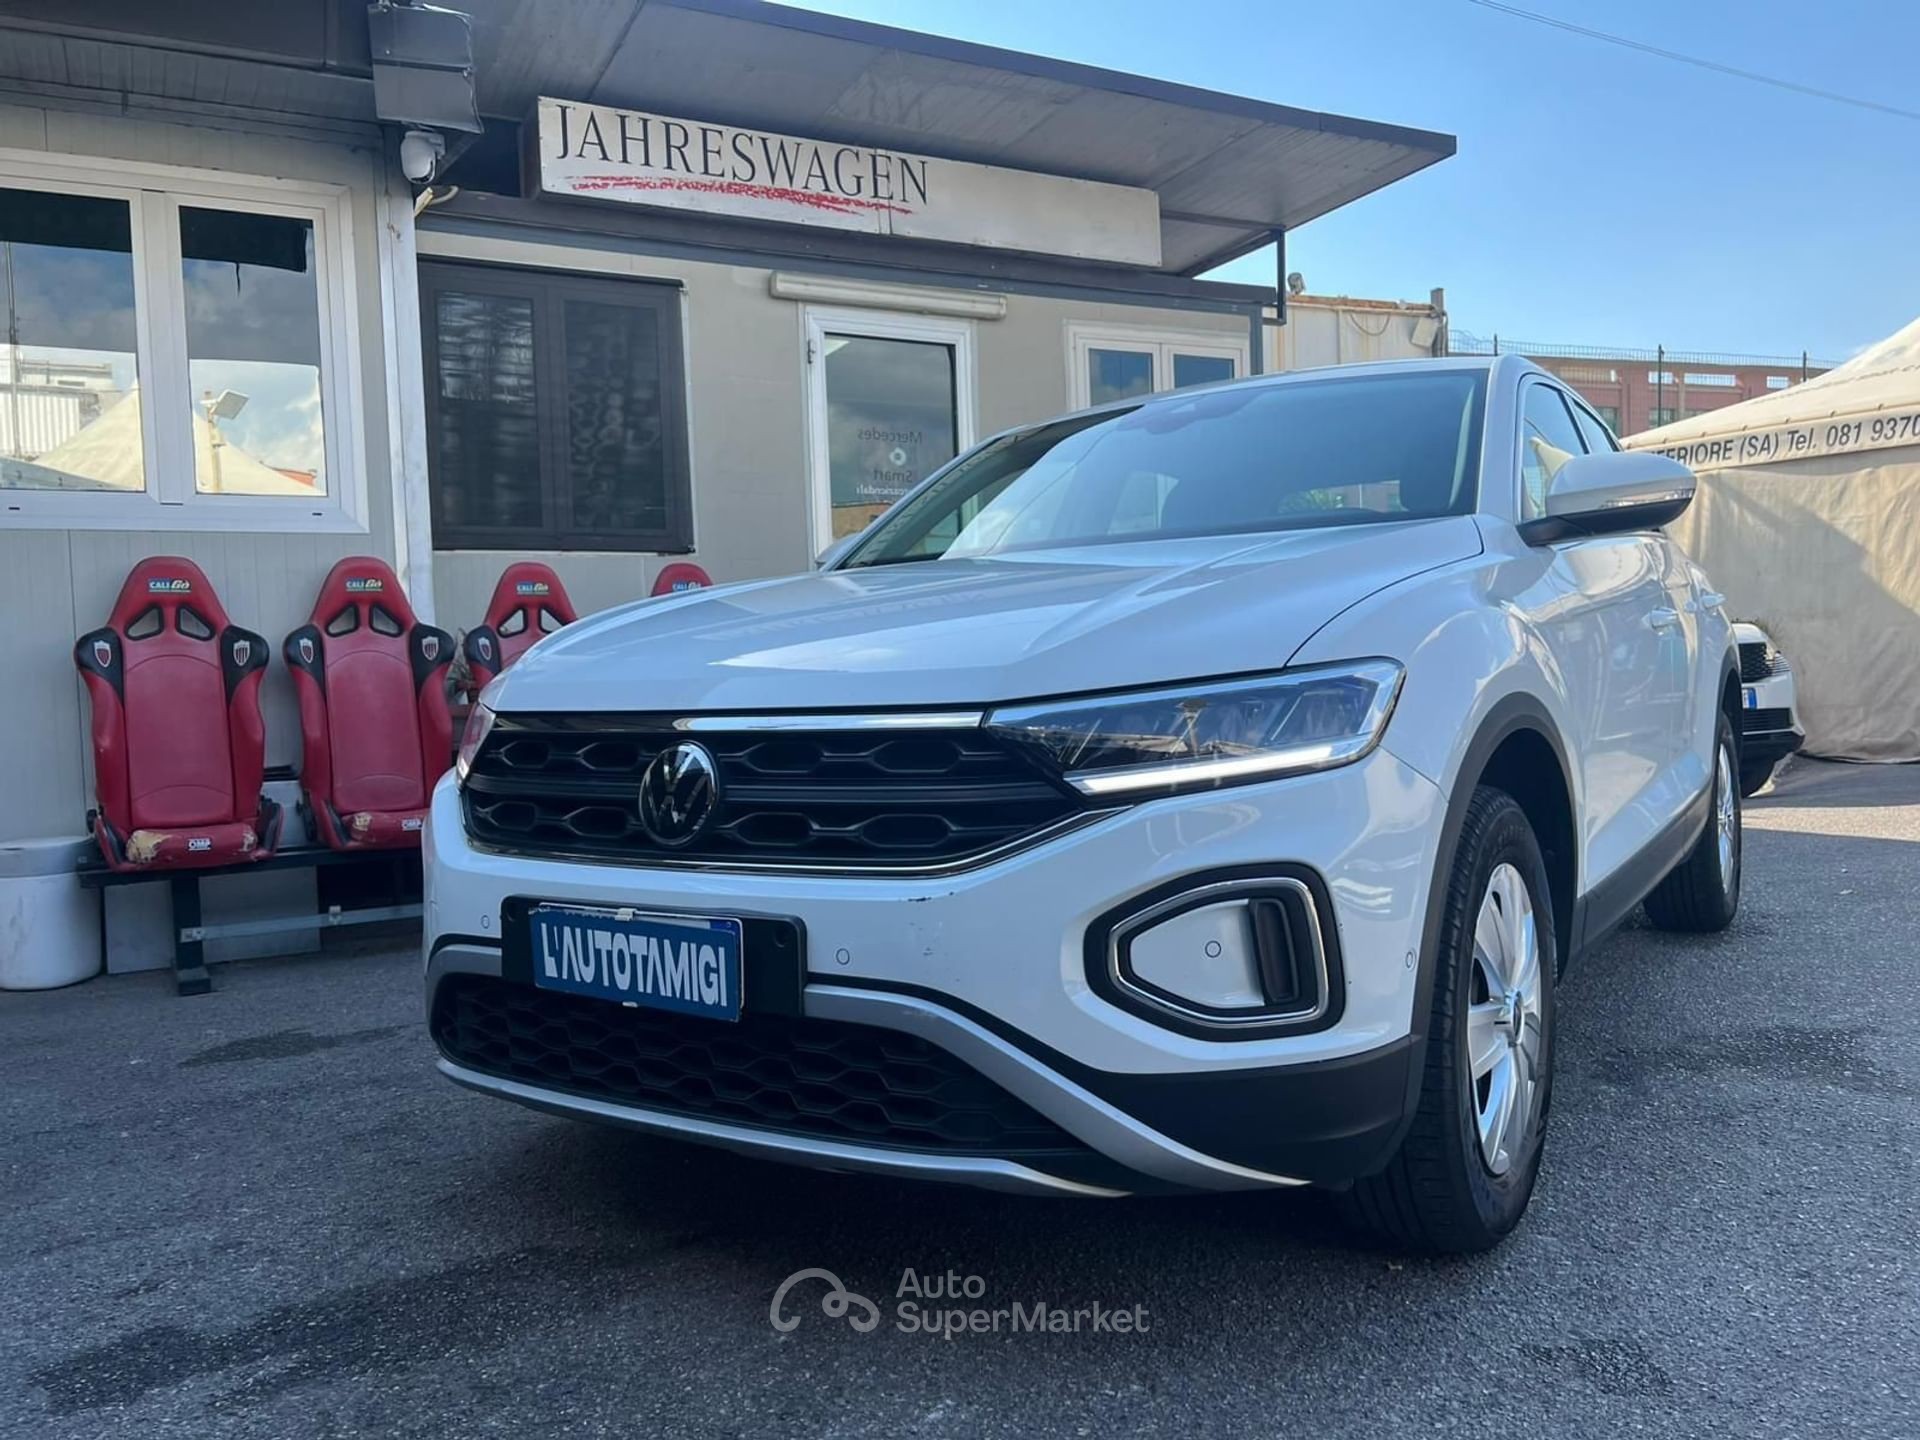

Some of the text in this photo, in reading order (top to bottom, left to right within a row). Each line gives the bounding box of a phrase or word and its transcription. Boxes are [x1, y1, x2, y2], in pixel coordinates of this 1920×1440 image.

[554, 104, 928, 205] JAHRESWAGEN
[1739, 432, 1779, 462] (SA)
[1787, 427, 1816, 452] Tel.
[1826, 421, 1862, 447] 081
[540, 922, 728, 1007] L'AUTOTAMIGI
